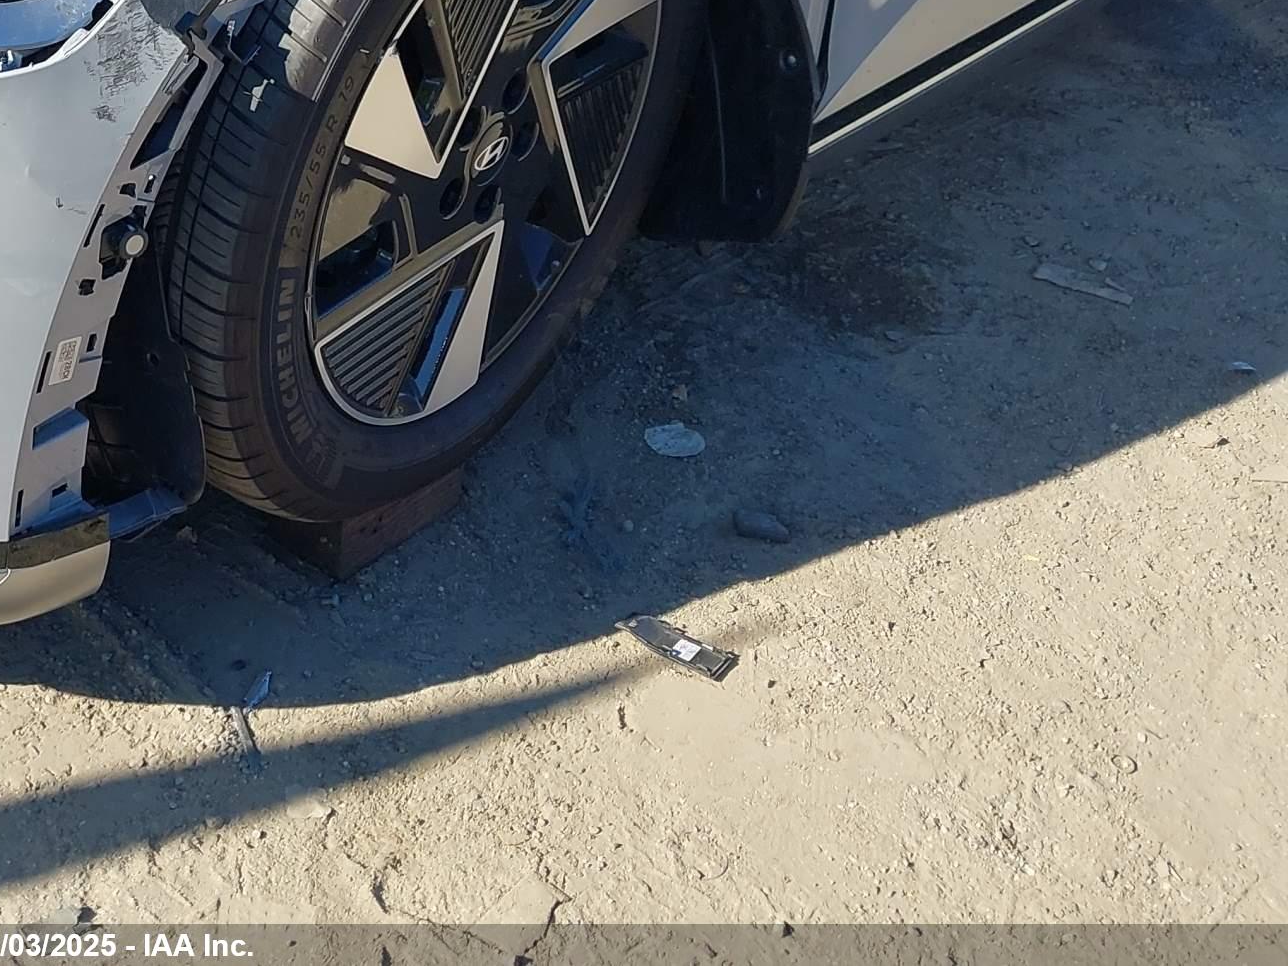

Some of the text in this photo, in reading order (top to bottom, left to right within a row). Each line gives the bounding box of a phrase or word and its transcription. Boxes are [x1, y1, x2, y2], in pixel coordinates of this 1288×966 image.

[289, 74, 355, 238] 235/55 R 19
[276, 278, 312, 445] MICHELIN
